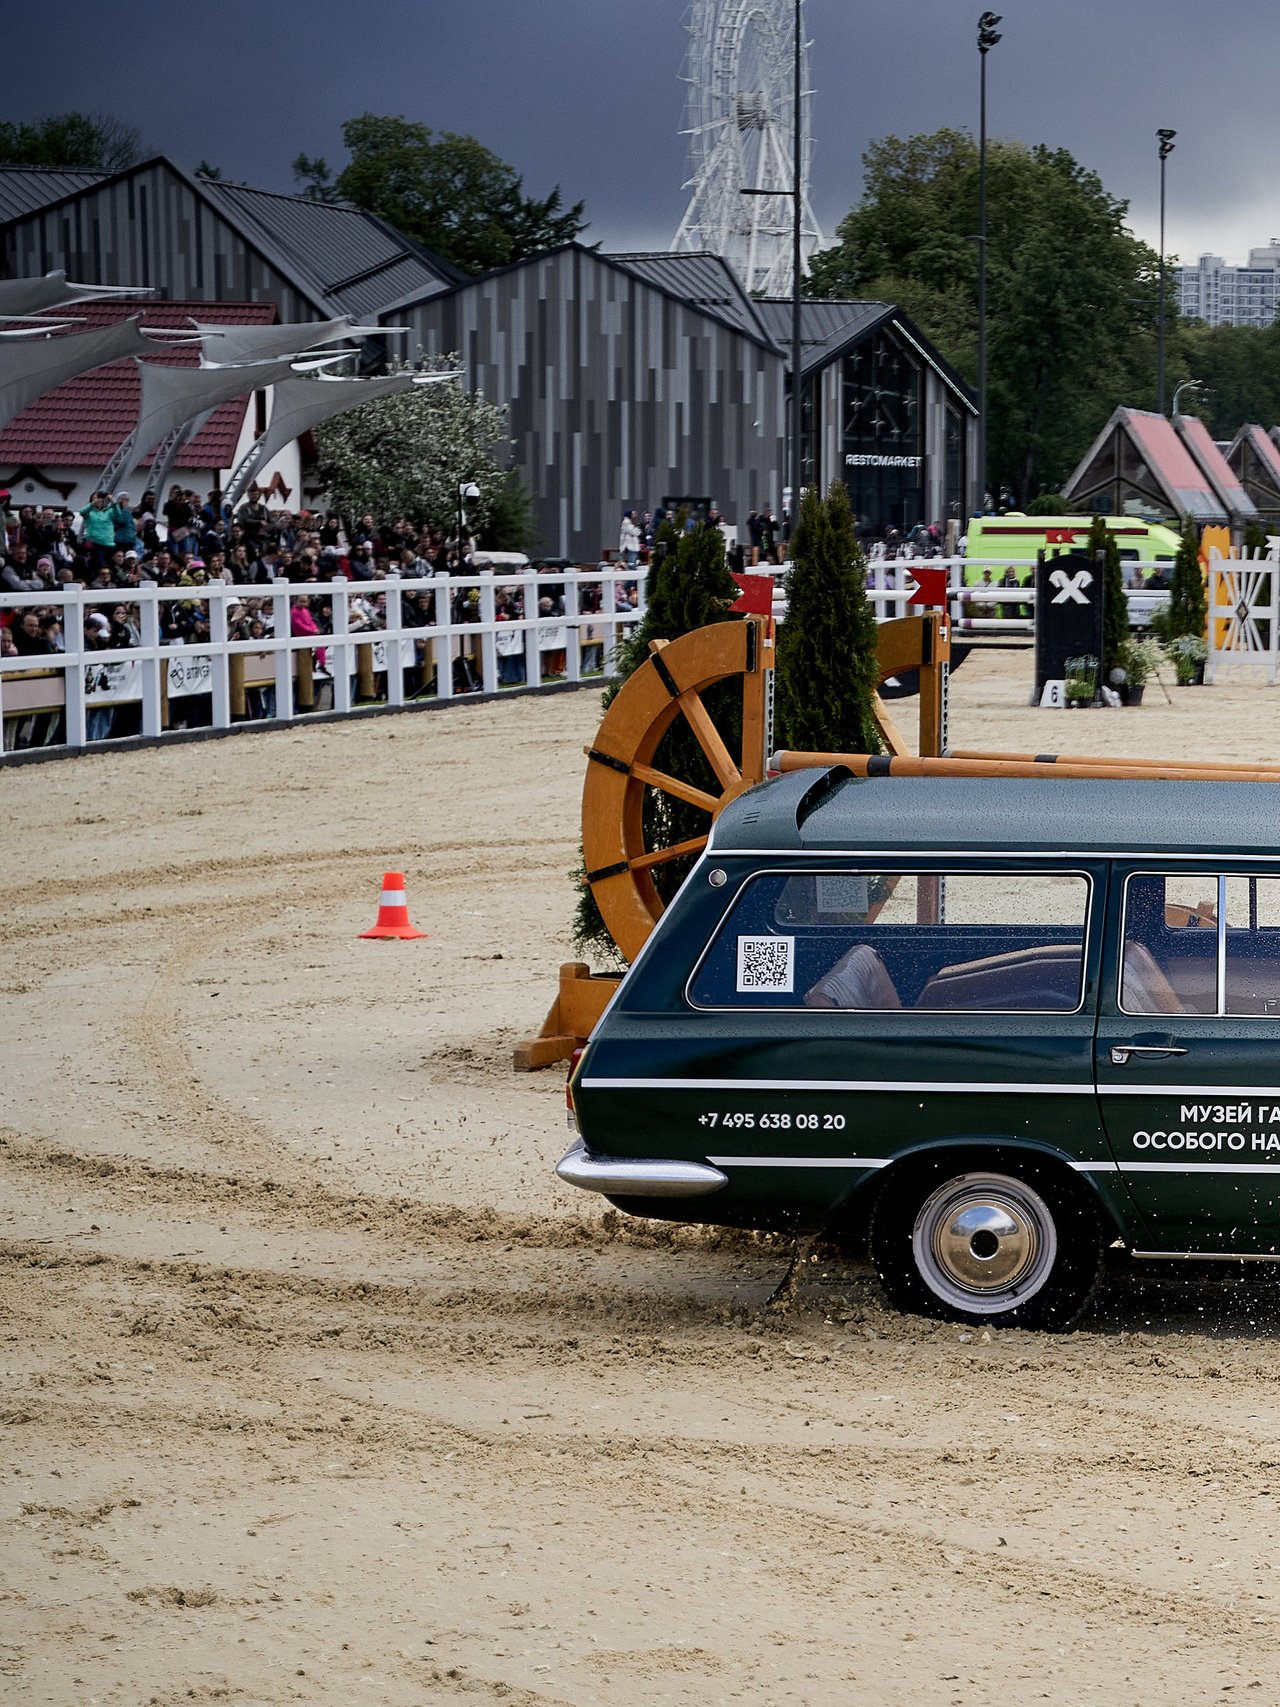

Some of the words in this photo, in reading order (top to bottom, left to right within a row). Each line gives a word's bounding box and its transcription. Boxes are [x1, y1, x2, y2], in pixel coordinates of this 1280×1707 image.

[845, 454, 923, 467] RESTOMARKET
[1051, 685, 1059, 703] 6
[698, 1112, 718, 1127] +7
[722, 1113, 755, 1128] 495
[759, 1113, 792, 1129] 638
[796, 1114, 819, 1129] 08
[823, 1114, 846, 1130] 20
[1180, 1102, 1252, 1123] МУЗЕЙ
[1132, 1131, 1246, 1150] ОСОБОГО
